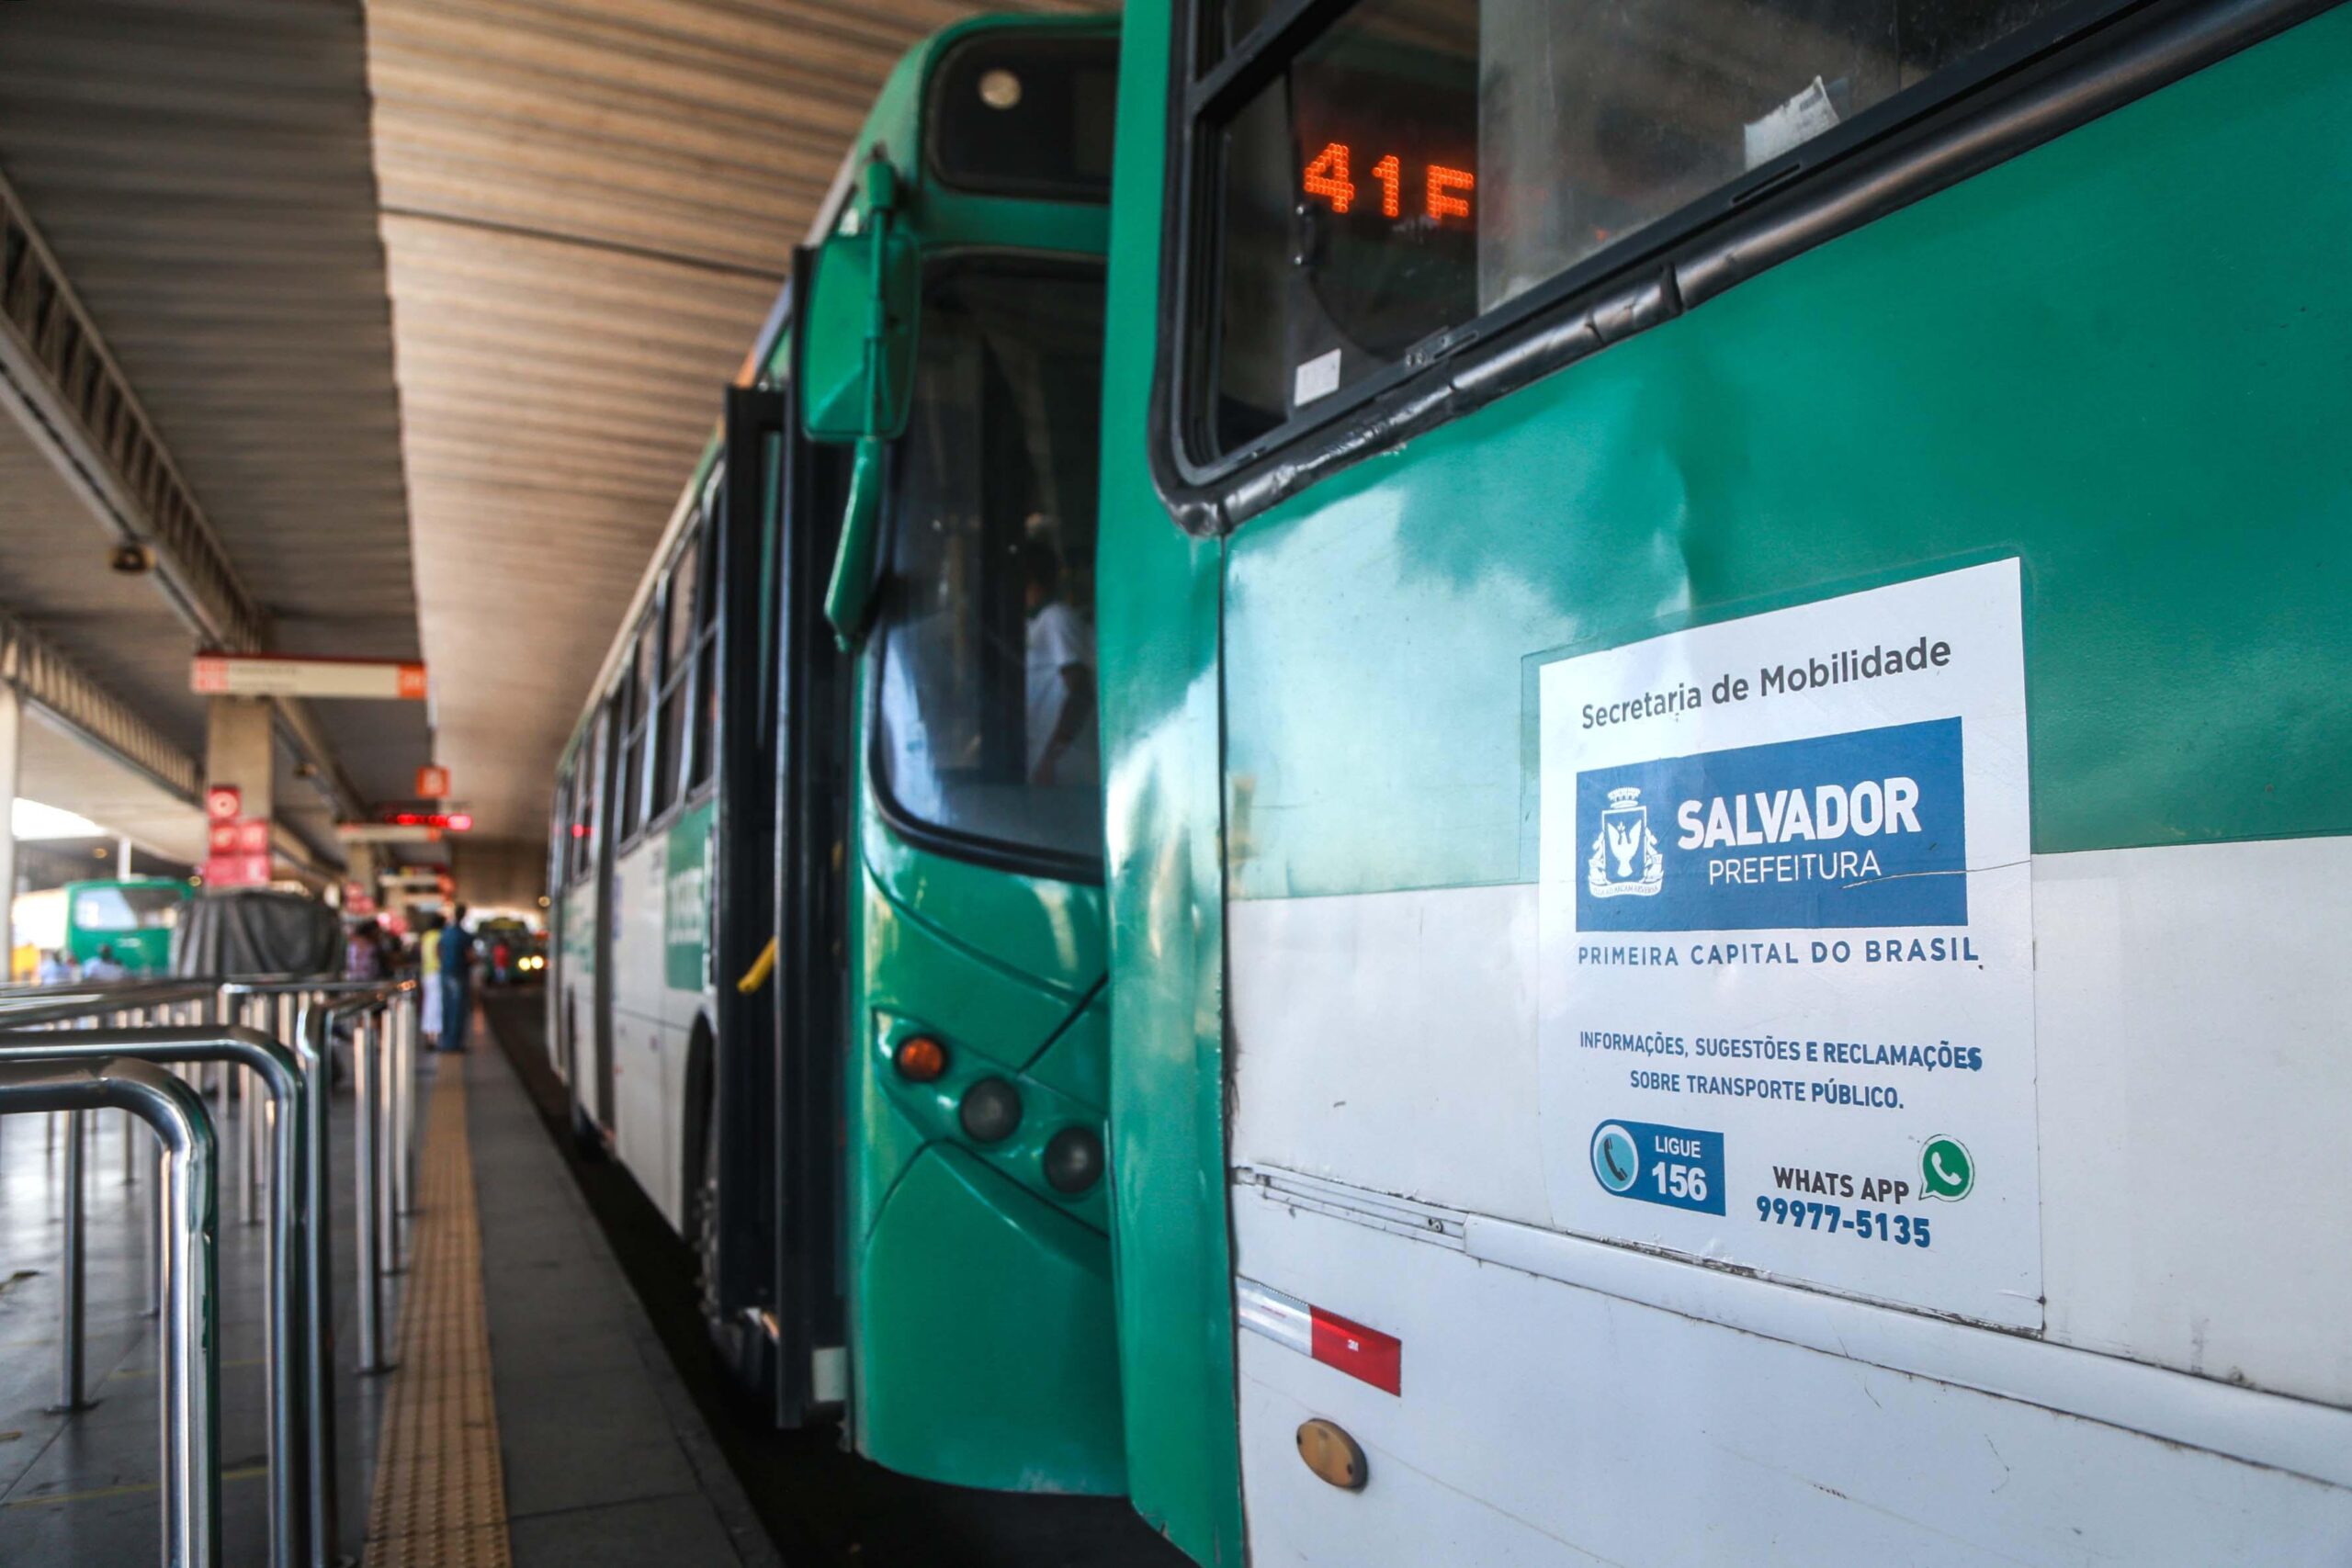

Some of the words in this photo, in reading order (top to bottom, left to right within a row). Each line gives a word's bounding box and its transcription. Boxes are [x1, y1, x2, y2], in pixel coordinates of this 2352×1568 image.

[1582, 683, 1702, 729] Secretaria
[1712, 673, 1749, 705] de
[1760, 636, 1951, 697] Mobilidade
[1677, 776, 1922, 851] SALVADOR
[1709, 850, 1882, 886] PREFEITURA
[1578, 946, 1679, 966] PRIMEIRA
[1690, 942, 1799, 965] CAPITAL
[1811, 941, 1851, 964] DO
[1865, 936, 1979, 963] BRASIL
[1580, 1031, 1689, 1058] INFORMAÇÕES,
[1695, 1034, 1801, 1061] SUGESTÕES
[1805, 1041, 1818, 1063] E
[1823, 1040, 1983, 1072] RECLAMAÇÕES
[1630, 1069, 1680, 1093] SOBRE
[1686, 1074, 1806, 1102] TRANSPORTE
[1811, 1077, 1905, 1110] PÚBLICO.
[1655, 1135, 1702, 1159] LIGUE
[1651, 1161, 1707, 1202] 156
[1772, 1165, 1854, 1198] WHATS
[1860, 1177, 1910, 1205] APP
[1756, 1195, 1931, 1249] 99977-5135
